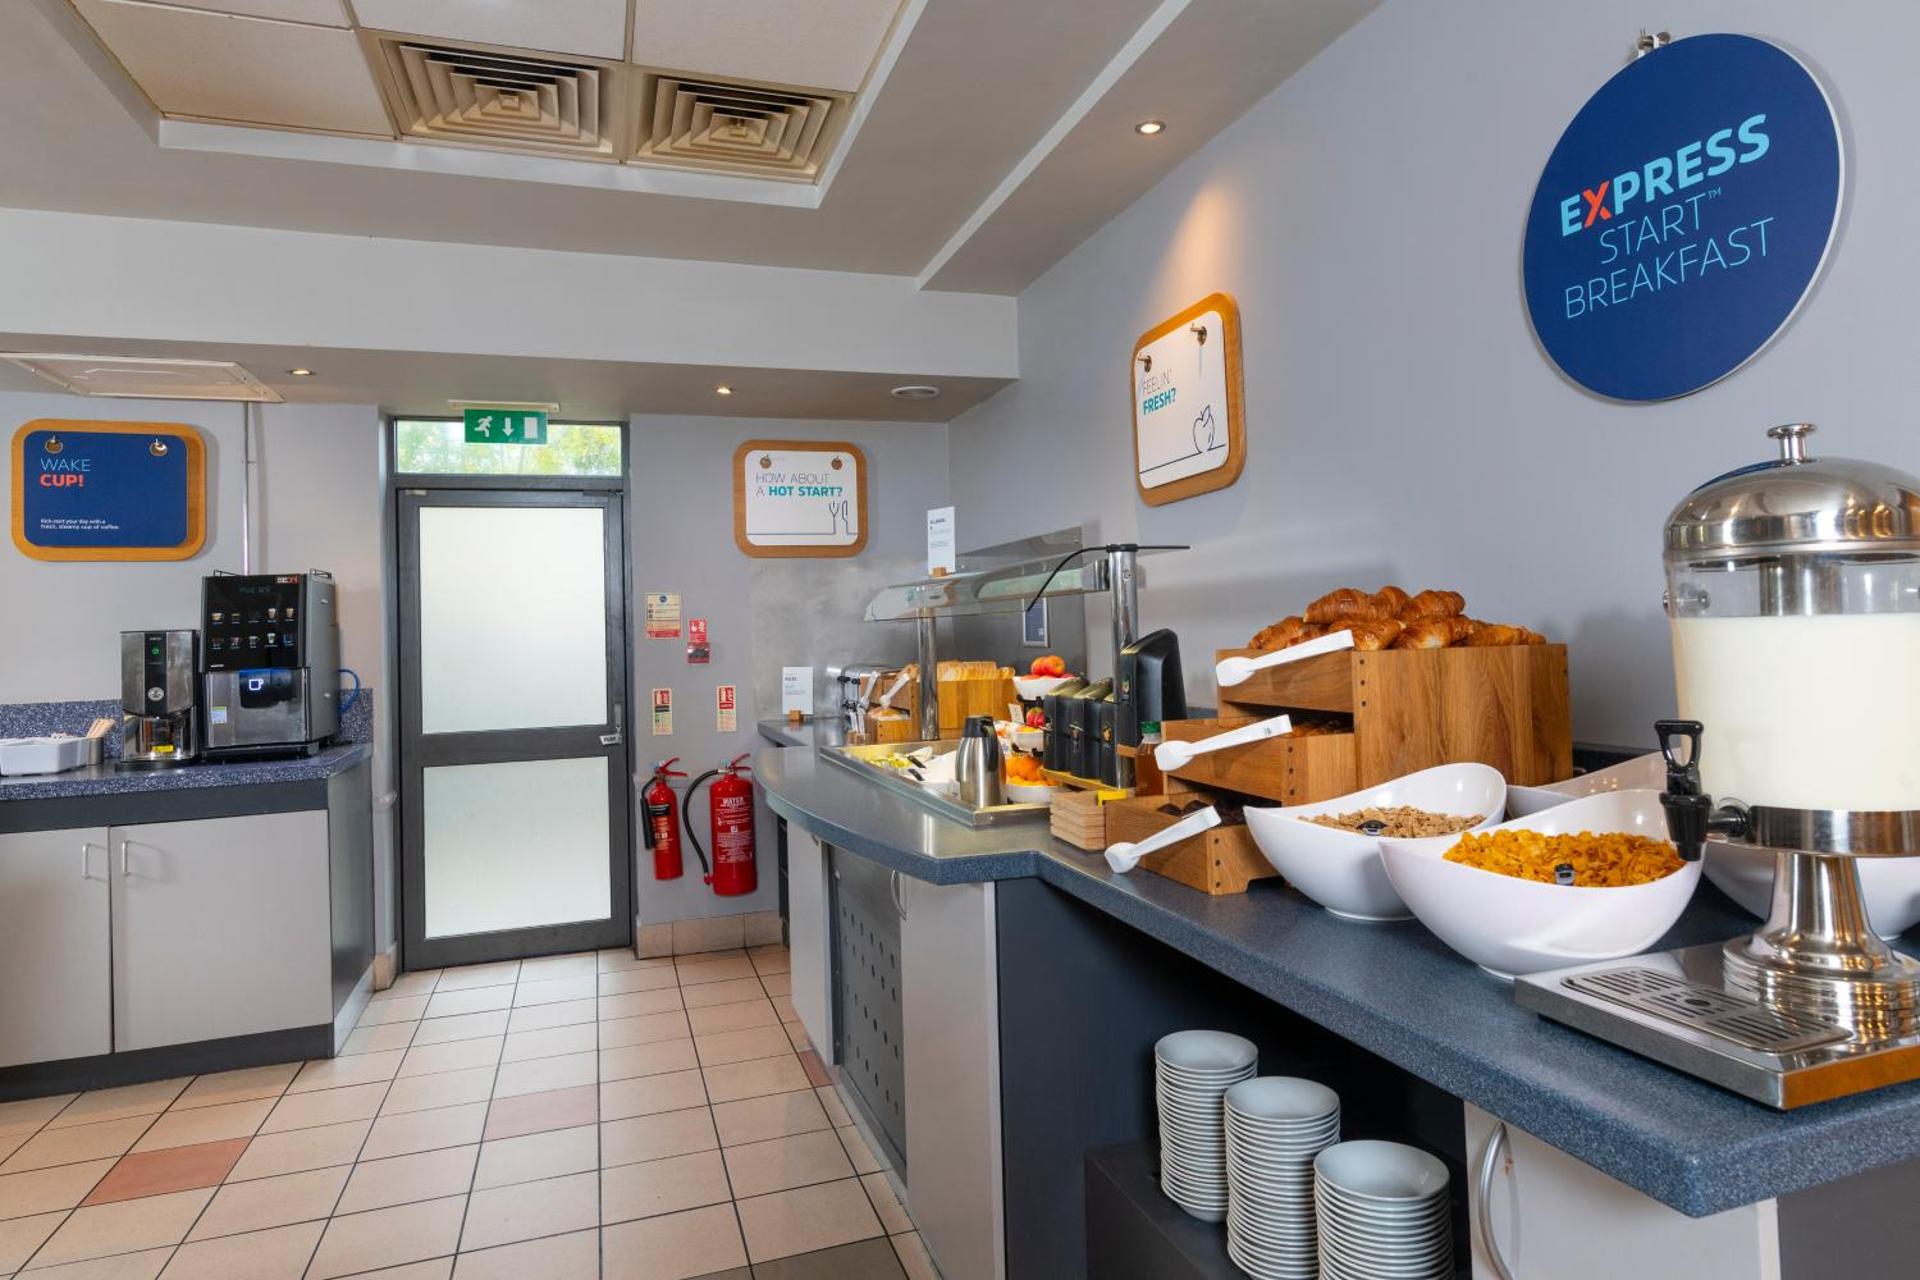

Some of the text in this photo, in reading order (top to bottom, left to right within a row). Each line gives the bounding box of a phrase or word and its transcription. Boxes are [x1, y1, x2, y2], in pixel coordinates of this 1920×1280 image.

[1561, 113, 1771, 237] EXPRESS
[1565, 217, 1775, 320] BREAKFAST
[1143, 388, 1176, 415] FRESH?
[40, 458, 91, 472] WAKE
[39, 474, 84, 487] CUP!
[755, 473, 830, 484] HOW ABOUT
[756, 486, 843, 497] A HOT START?
